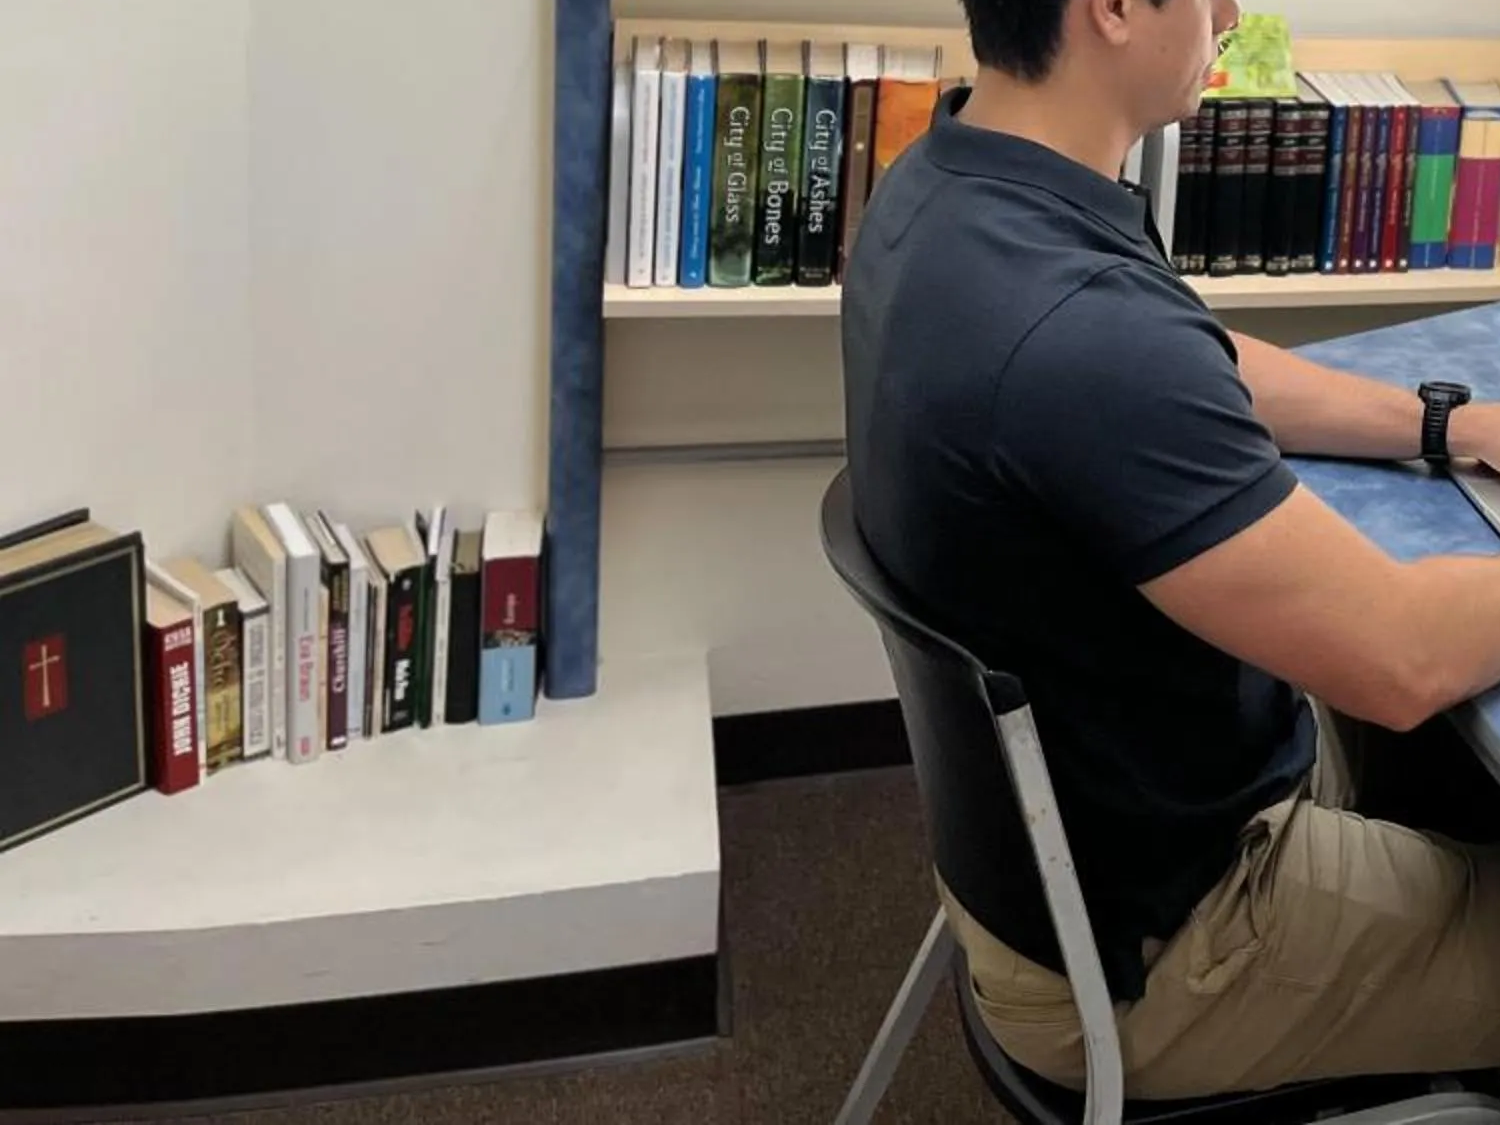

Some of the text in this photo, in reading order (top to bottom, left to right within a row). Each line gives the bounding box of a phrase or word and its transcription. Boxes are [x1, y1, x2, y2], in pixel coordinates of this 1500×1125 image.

[724, 106, 750, 148] City
[764, 107, 793, 153] City
[809, 110, 837, 153] City
[725, 171, 746, 223] Glass
[765, 180, 789, 246] Bones
[808, 175, 831, 233] Ashes
[332, 628, 346, 692] Churchill
[172, 716, 192, 756] JOHN
